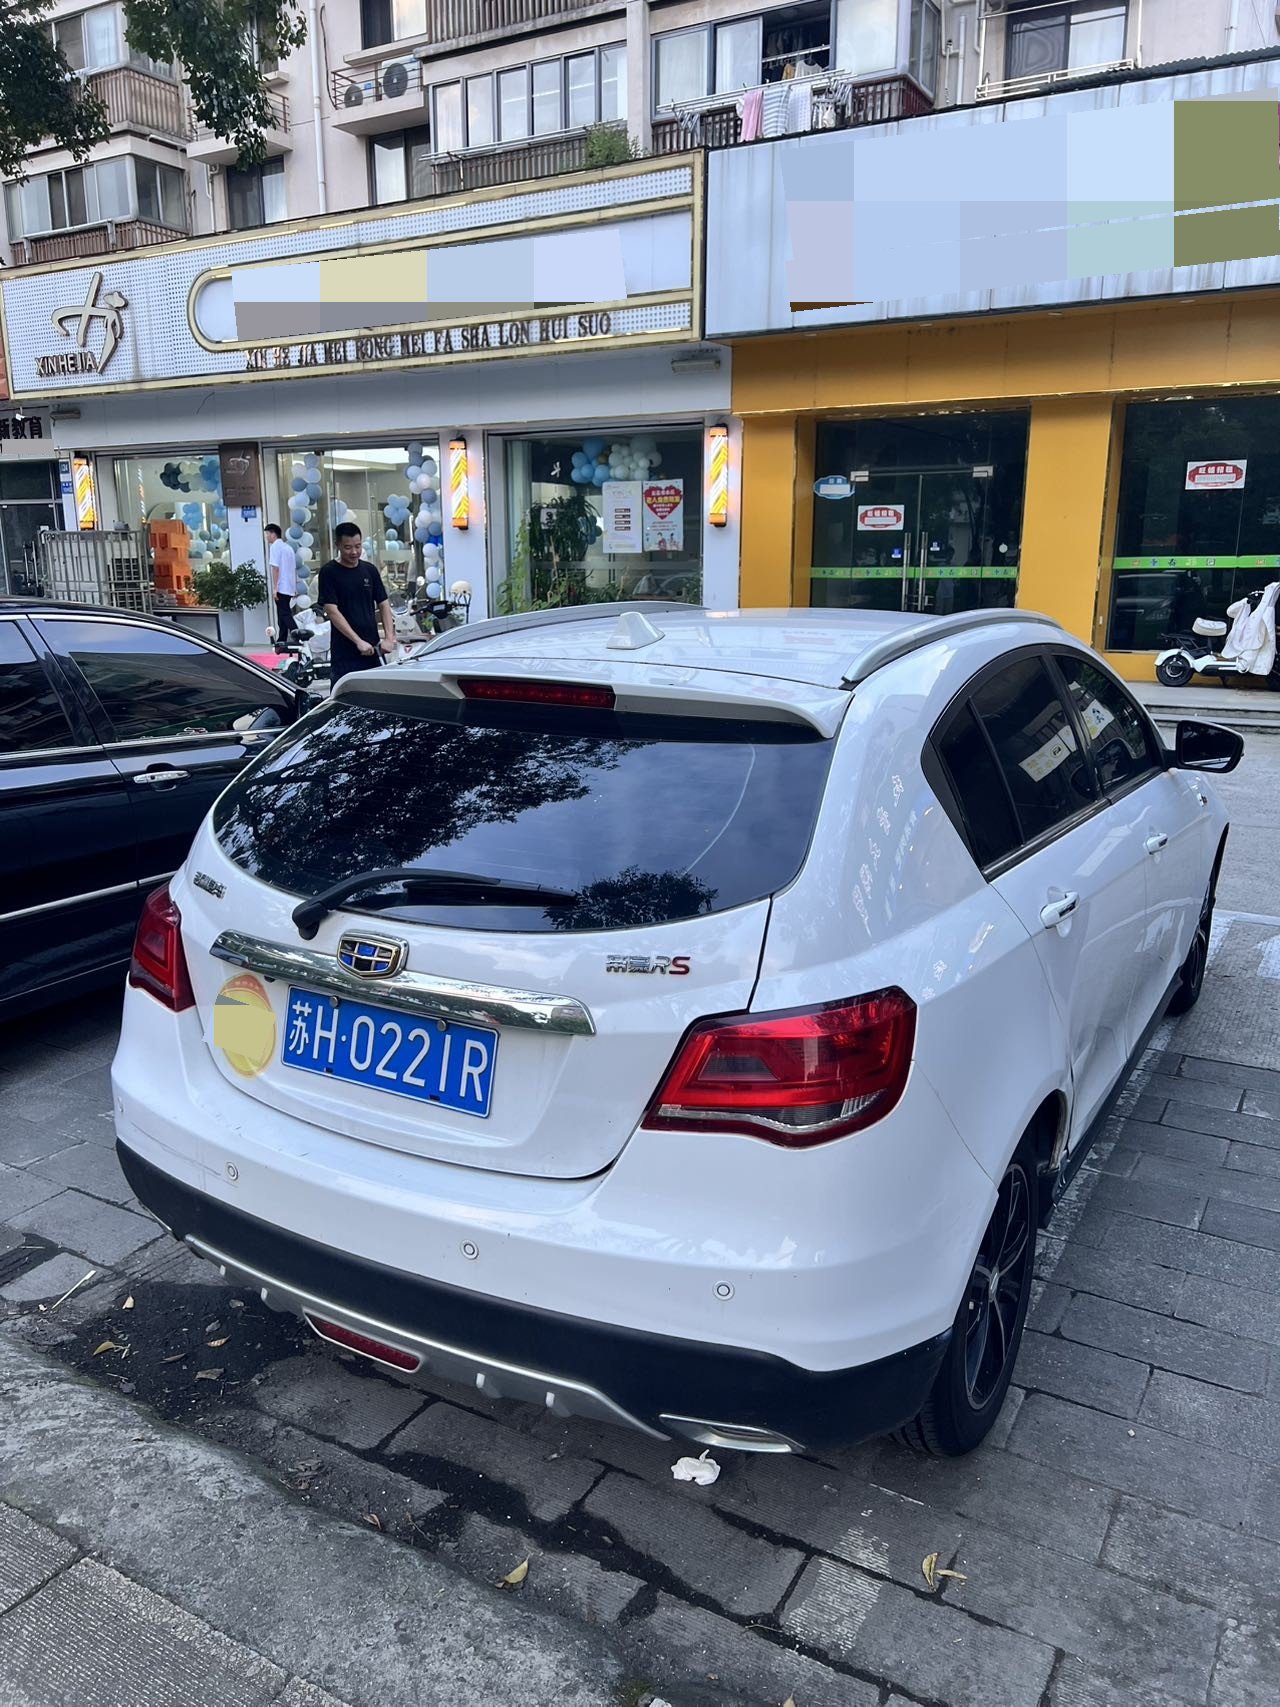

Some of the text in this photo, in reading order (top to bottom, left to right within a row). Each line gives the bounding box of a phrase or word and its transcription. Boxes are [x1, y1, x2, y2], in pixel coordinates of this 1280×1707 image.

[434, 330, 453, 352] FA
[461, 325, 490, 349] SHA
[499, 321, 530, 345] LON
[539, 317, 569, 341] HUI
[577, 312, 611, 337] SUO
